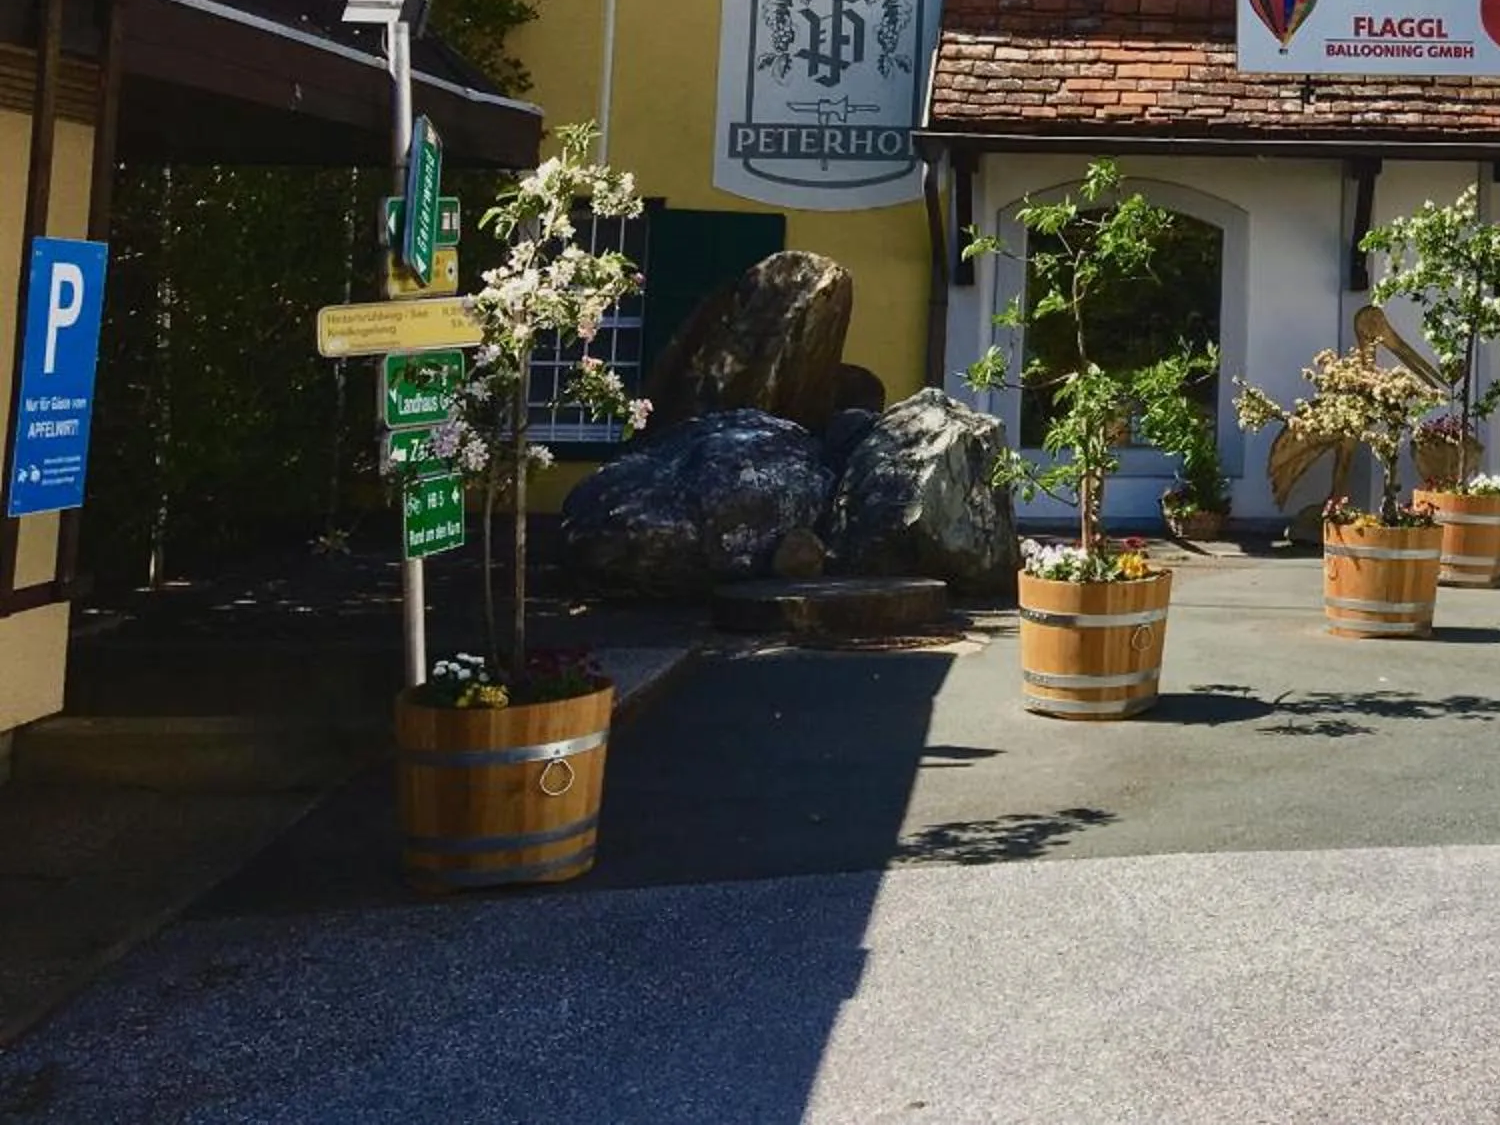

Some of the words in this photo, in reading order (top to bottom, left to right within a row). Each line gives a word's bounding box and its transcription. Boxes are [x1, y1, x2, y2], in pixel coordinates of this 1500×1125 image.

[1353, 16, 1448, 38] FLAGGL
[1325, 44, 1423, 59] BALLOONING
[1427, 46, 1475, 60] GMBH
[735, 127, 916, 157] PETERHO
[43, 262, 85, 375] P
[397, 392, 438, 416] Landhaus
